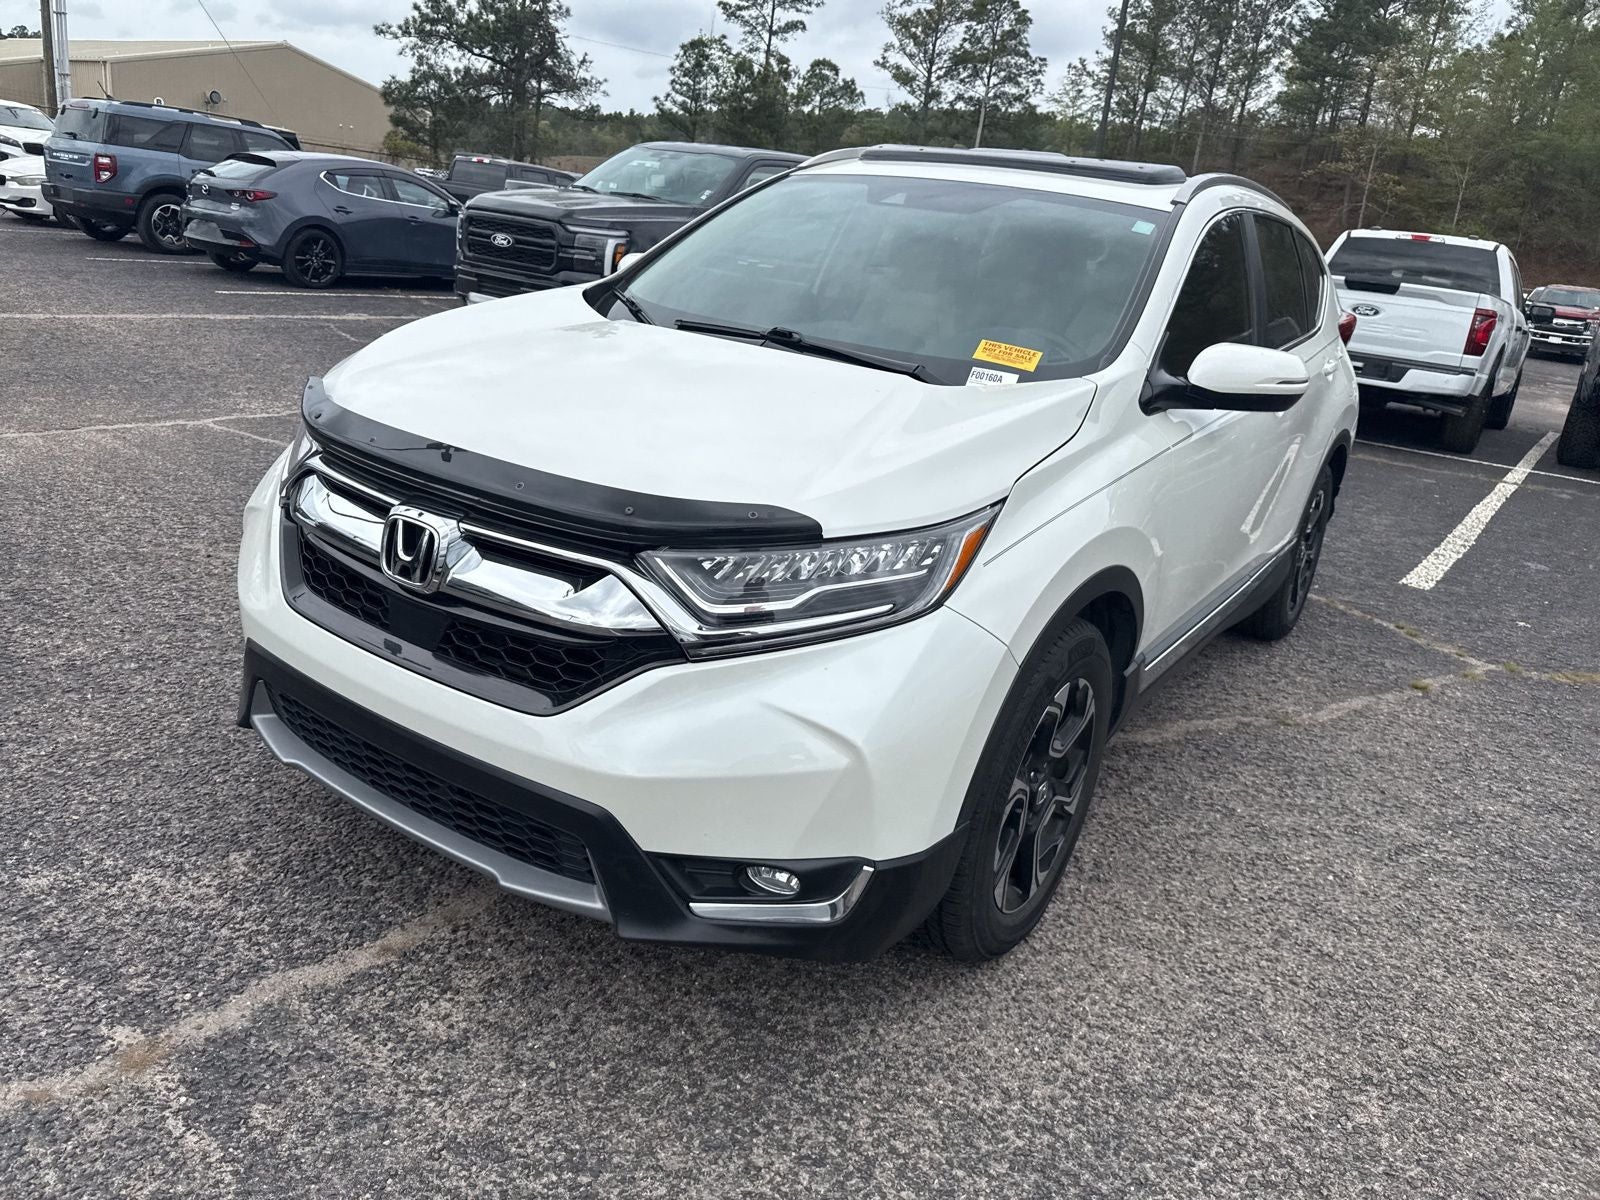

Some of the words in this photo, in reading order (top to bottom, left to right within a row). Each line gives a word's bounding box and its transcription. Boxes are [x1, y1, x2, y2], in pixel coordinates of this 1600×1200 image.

[984, 341, 1002, 349] THIS
[1004, 345, 1039, 357] VEHICLE
[1014, 353, 1033, 361] SALE
[970, 370, 1003, 383] F00160A
